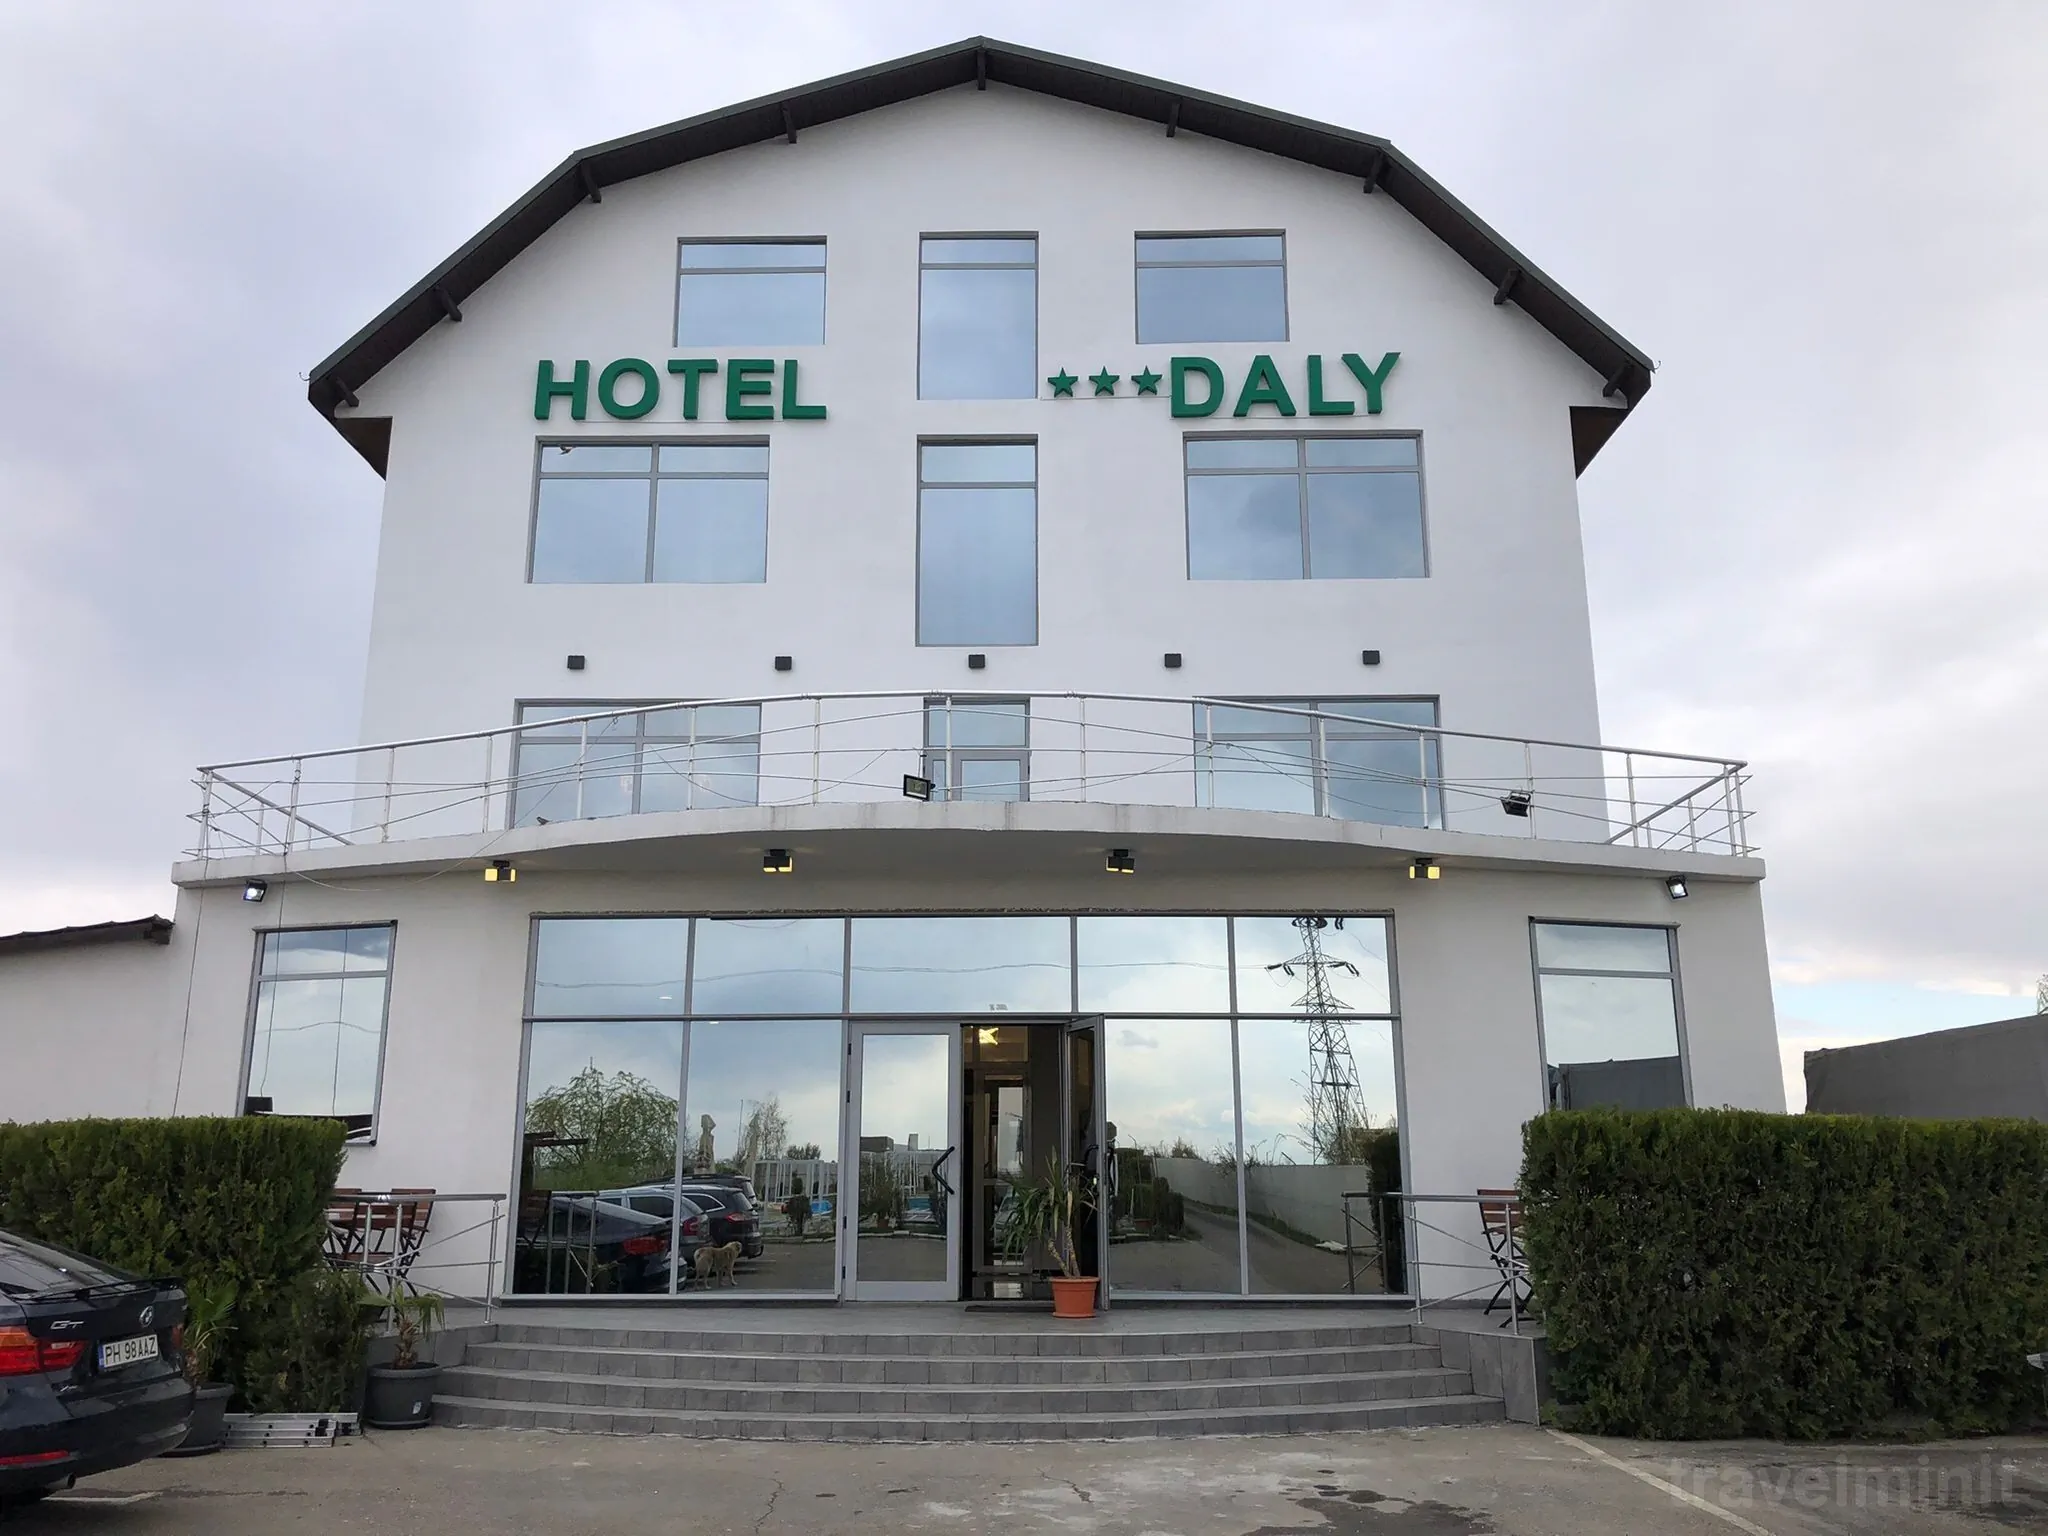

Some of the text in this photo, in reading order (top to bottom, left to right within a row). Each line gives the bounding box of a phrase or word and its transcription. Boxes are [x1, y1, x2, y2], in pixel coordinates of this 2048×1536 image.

[535, 358, 827, 420] HOTEL
[1170, 352, 1401, 418] DALY
[50, 1320, 84, 1330] GT
[105, 1346, 121, 1364] PH
